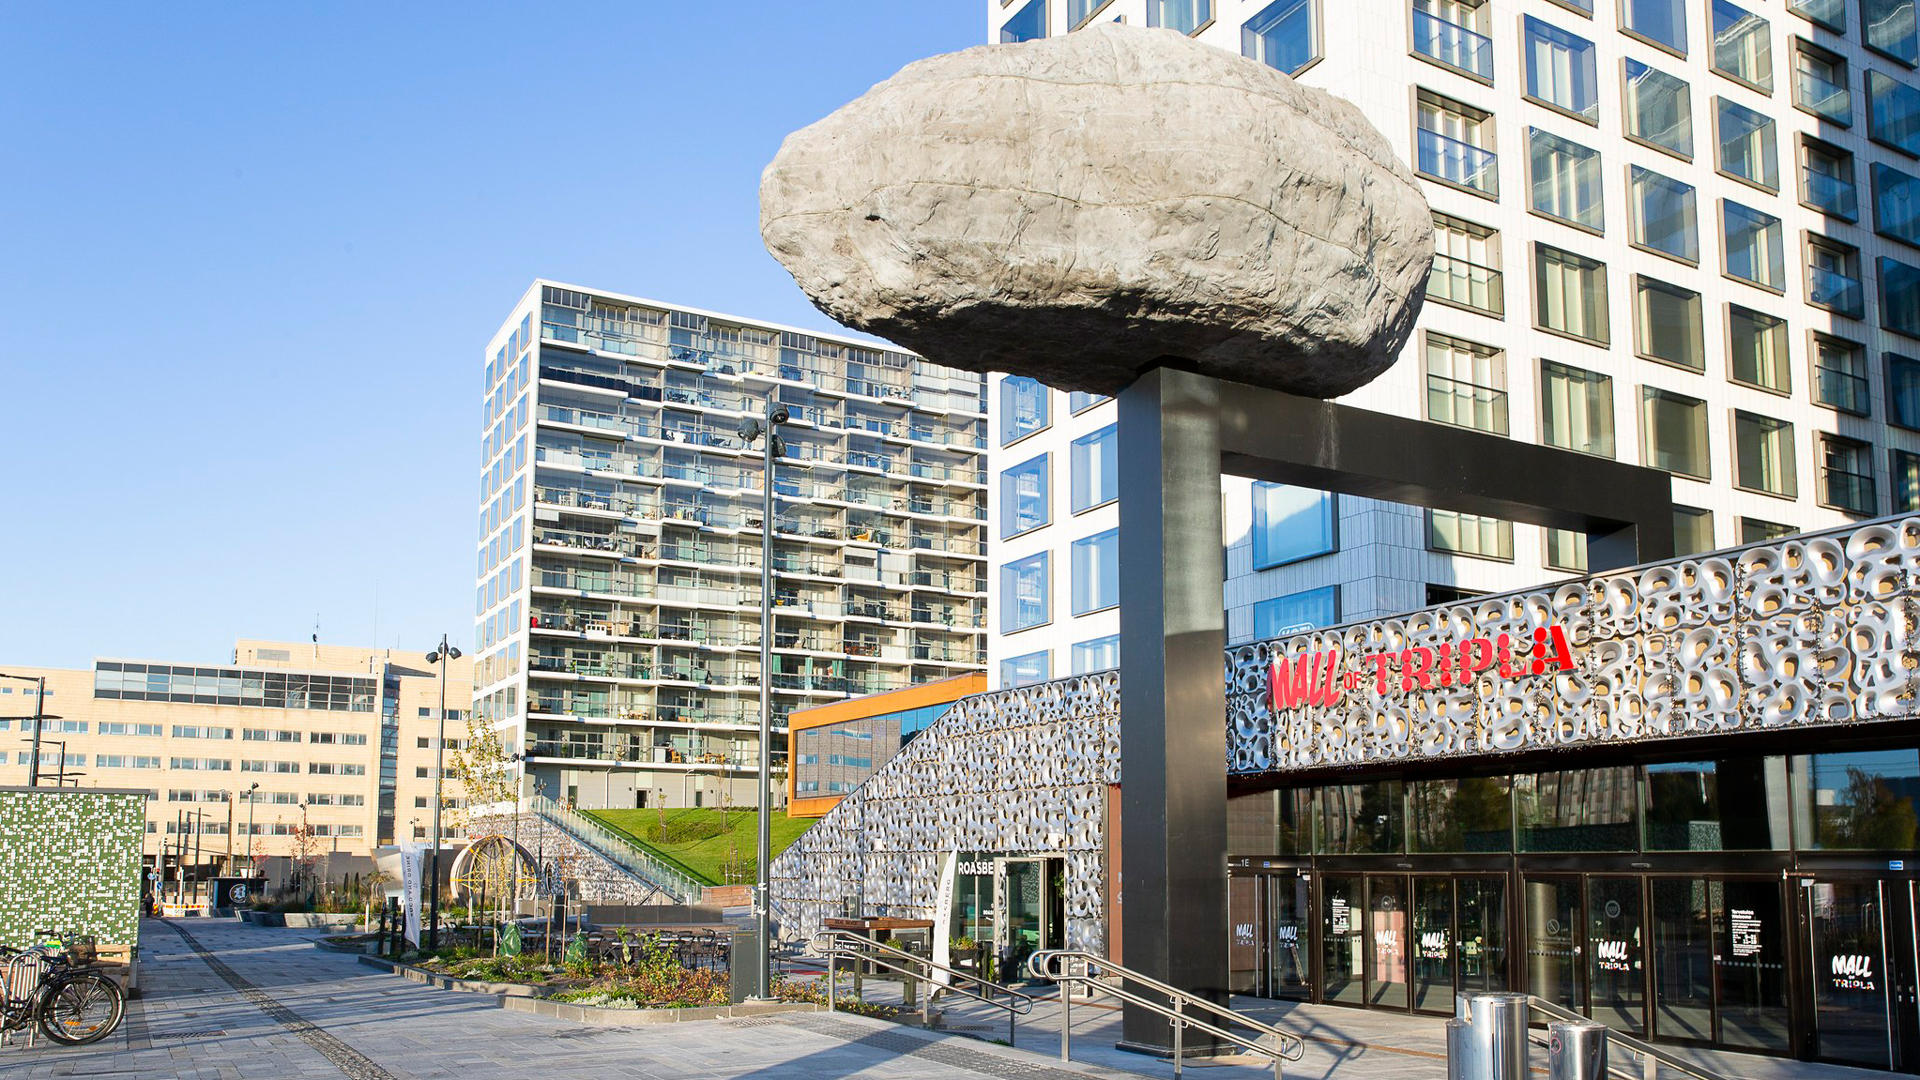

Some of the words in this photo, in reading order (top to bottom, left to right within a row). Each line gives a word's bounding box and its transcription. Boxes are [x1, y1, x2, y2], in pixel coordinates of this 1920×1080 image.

[1269, 650, 1340, 710] MALL
[1344, 673, 1361, 690] OF
[1366, 625, 1576, 695] TRIPLA
[958, 861, 1006, 875] ROASBEG
[1376, 930, 1397, 946] MALL
[1421, 932, 1445, 949] MALL
[1598, 941, 1628, 960] MALL
[1599, 961, 1630, 971] TRIPLA
[1832, 954, 1872, 977] MALL
[1833, 979, 1875, 990] TRIPLA
